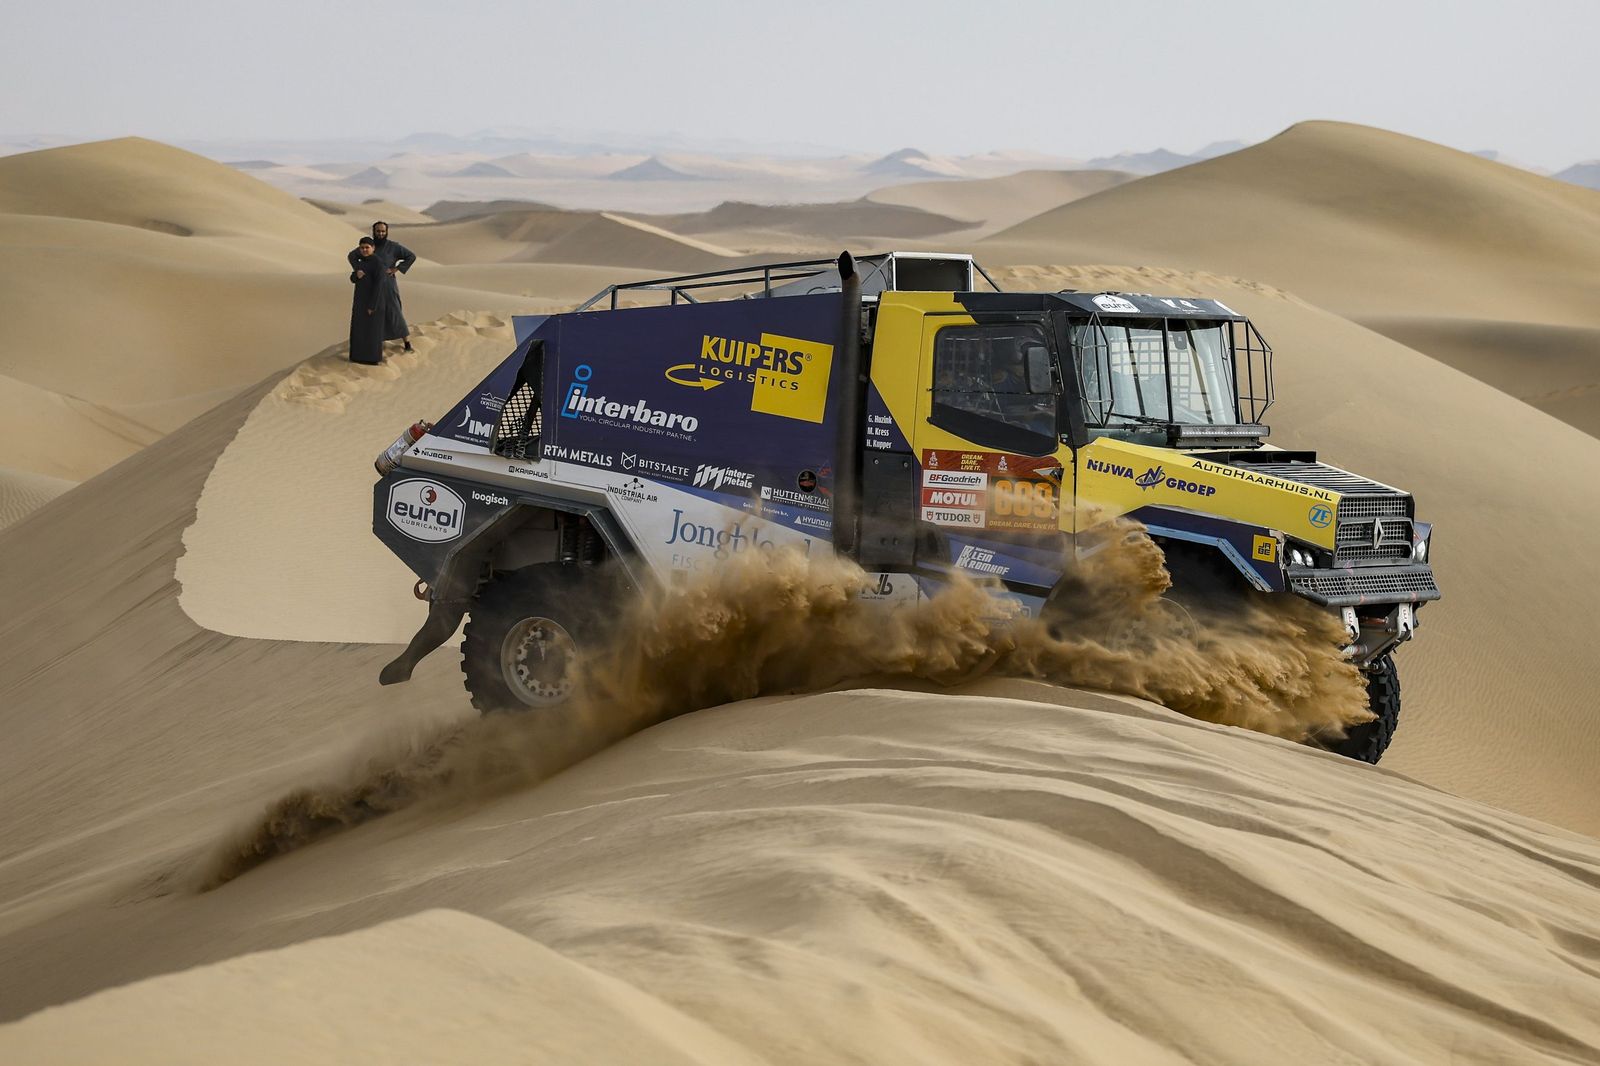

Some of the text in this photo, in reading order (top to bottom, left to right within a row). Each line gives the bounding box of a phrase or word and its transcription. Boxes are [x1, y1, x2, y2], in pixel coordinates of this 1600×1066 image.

[699, 364, 799, 390] LOGISTICS
[570, 389, 697, 432] interbaro
[468, 419, 495, 438] IM
[598, 417, 631, 430] CIRCULAR
[632, 425, 665, 436] INDUSTRY
[666, 432, 698, 443] PATNE
[420, 449, 453, 461] NIJBOER
[543, 444, 613, 468] RTM METALS
[514, 466, 549, 479] KAMPHUIS
[638, 459, 691, 477] BITSTAETE
[929, 473, 982, 485] BFGoodrich
[1086, 458, 1135, 480] NIJWA
[1165, 476, 1217, 497] GROEP
[471, 490, 509, 507] loogisch
[606, 485, 658, 503] INDUSTRIAL AIR
[930, 491, 978, 506] MOTUL
[394, 501, 459, 529] eurol
[935, 512, 972, 523] TUDOR
[401, 519, 448, 534] LUBRICANTS
[665, 508, 811, 562] Jongblo
